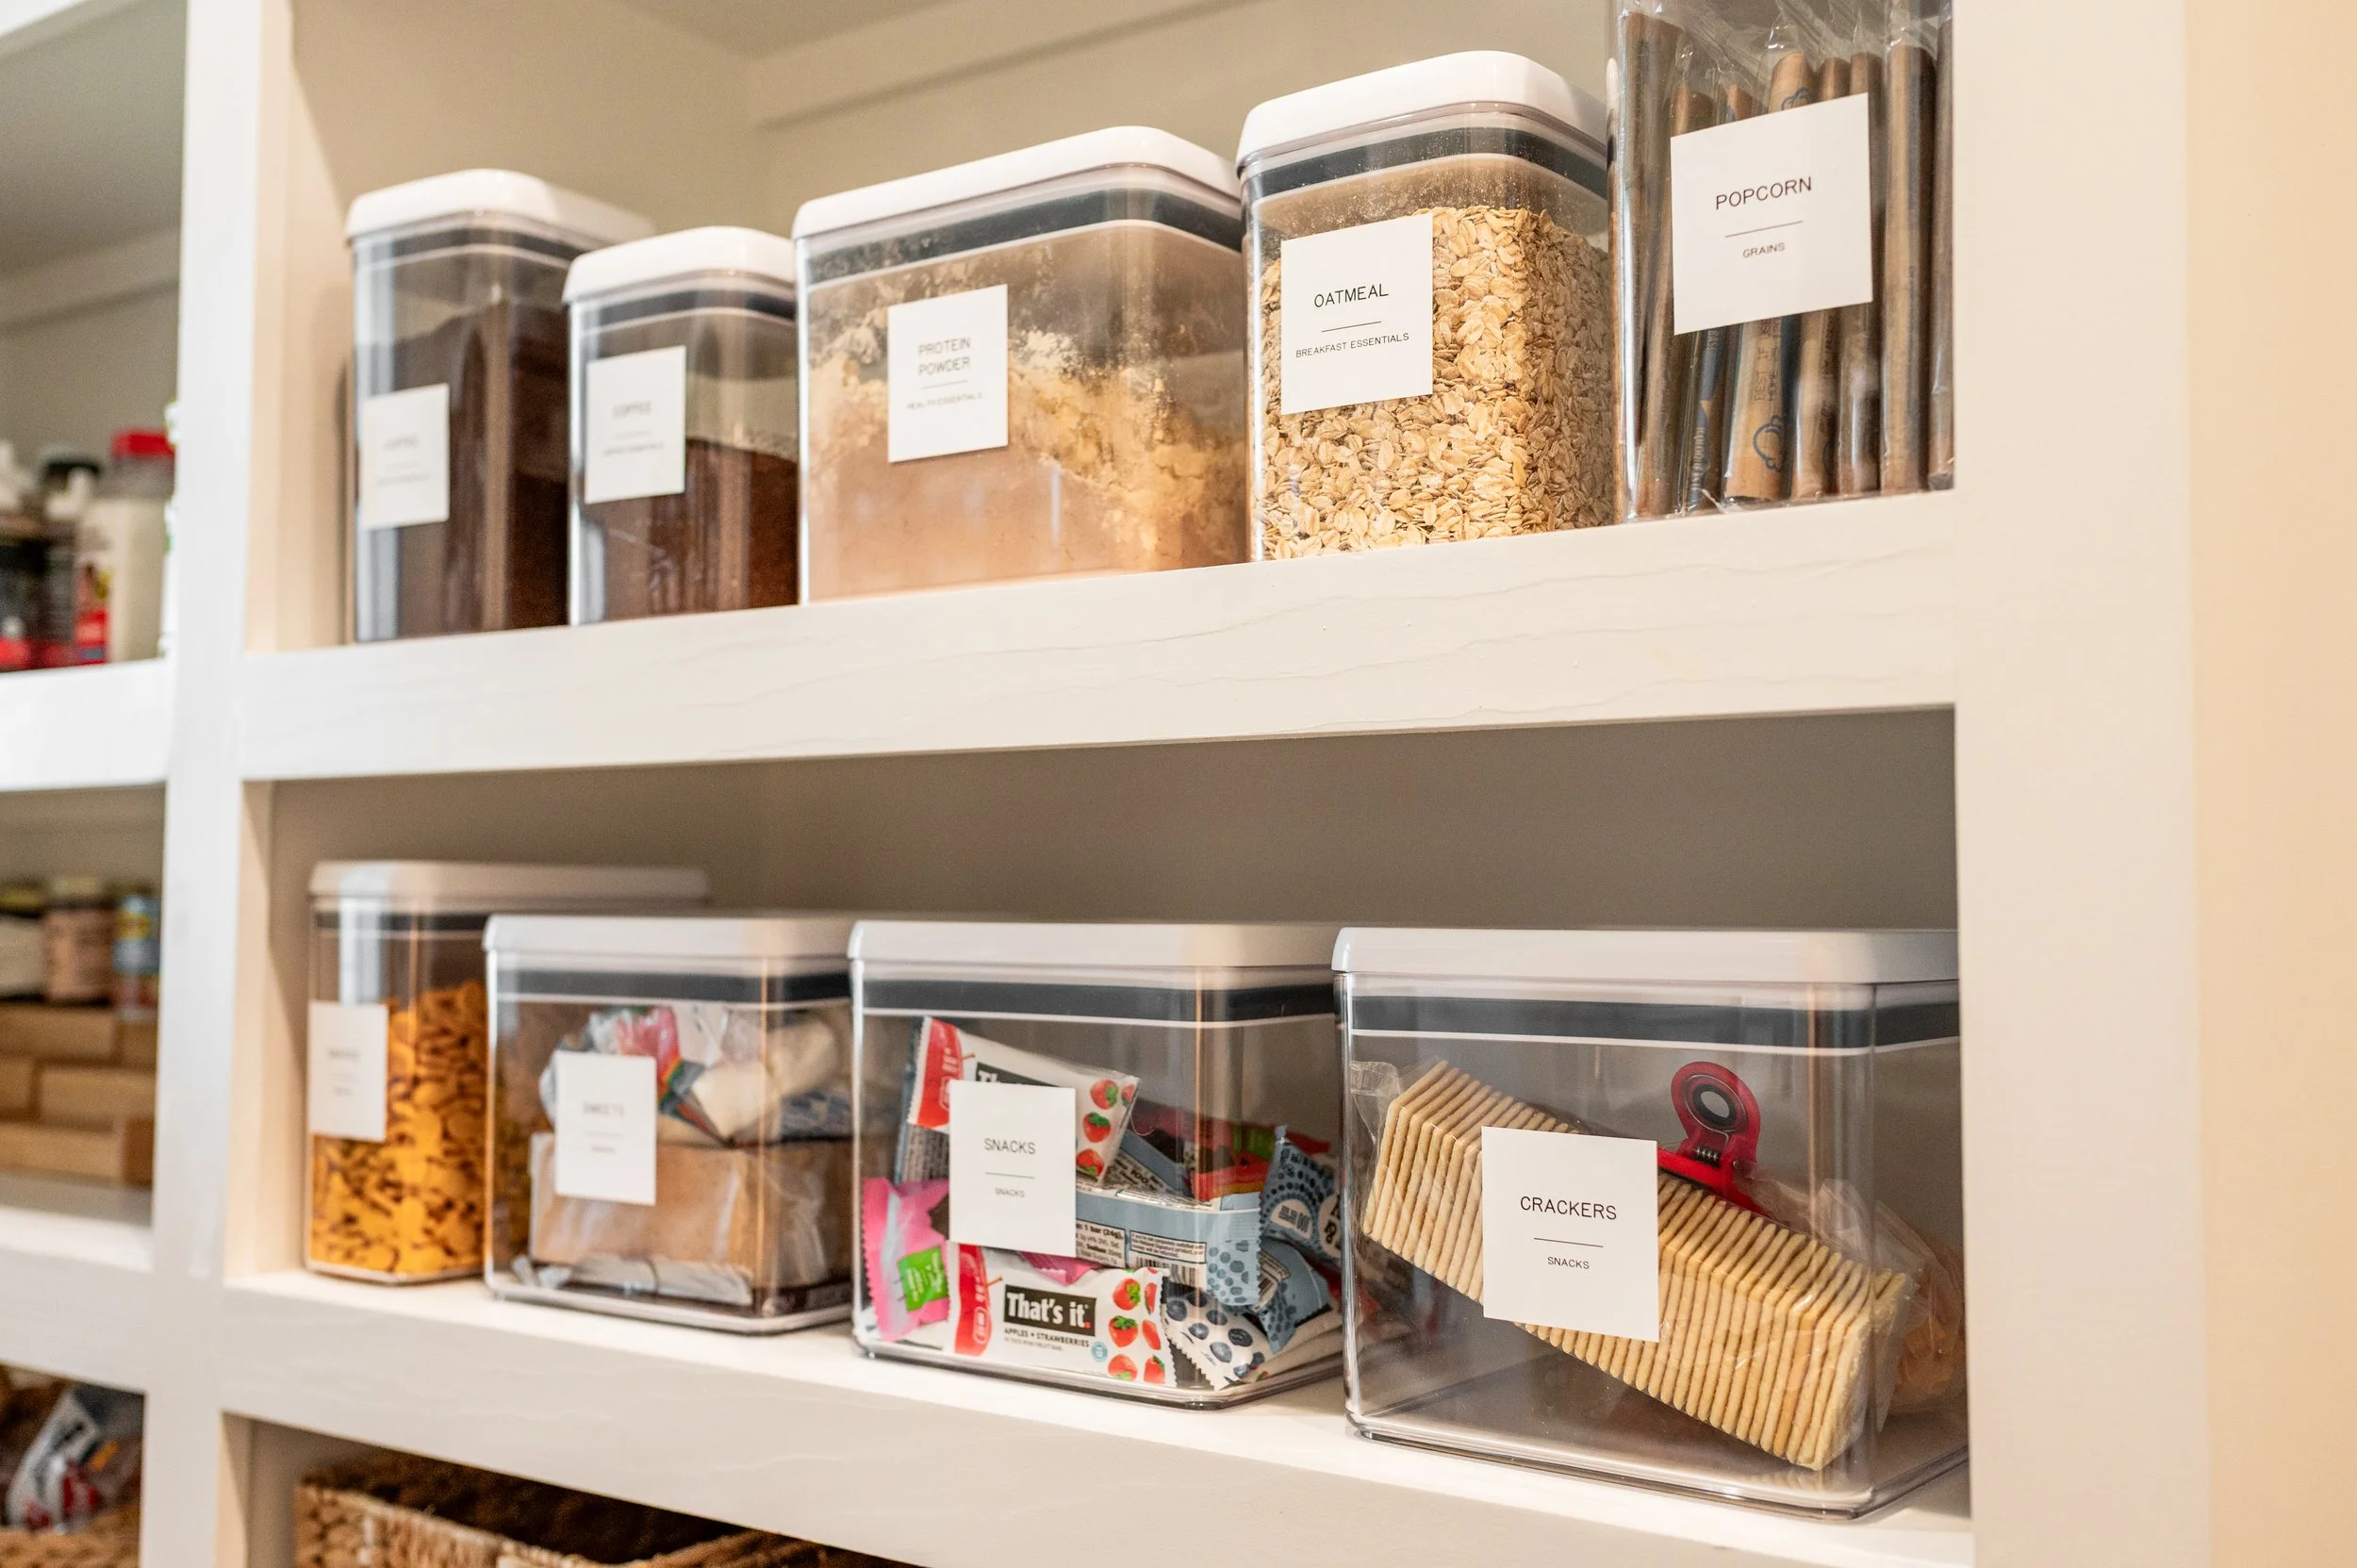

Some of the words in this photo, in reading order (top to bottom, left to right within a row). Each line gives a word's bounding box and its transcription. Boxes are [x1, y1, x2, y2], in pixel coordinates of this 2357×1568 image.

[1715, 175, 1812, 210] POPCORN
[1742, 242, 1786, 259] GRAINS
[1313, 283, 1390, 308] OATMEAL
[917, 337, 971, 357] PROTEIN
[1295, 341, 1348, 358] BREAKFAST
[1350, 332, 1410, 350] ESSENTIALS
[917, 356, 971, 376] POWDER
[983, 1136, 1037, 1155] SNACKS
[1519, 1196, 1618, 1220] CRACKERS
[1546, 1256, 1591, 1270] SNACKS
[1006, 1292, 1063, 1325] That's
[1004, 1328, 1030, 1339] APPLES
[1036, 1332, 1090, 1348] STRAWBERRIES
